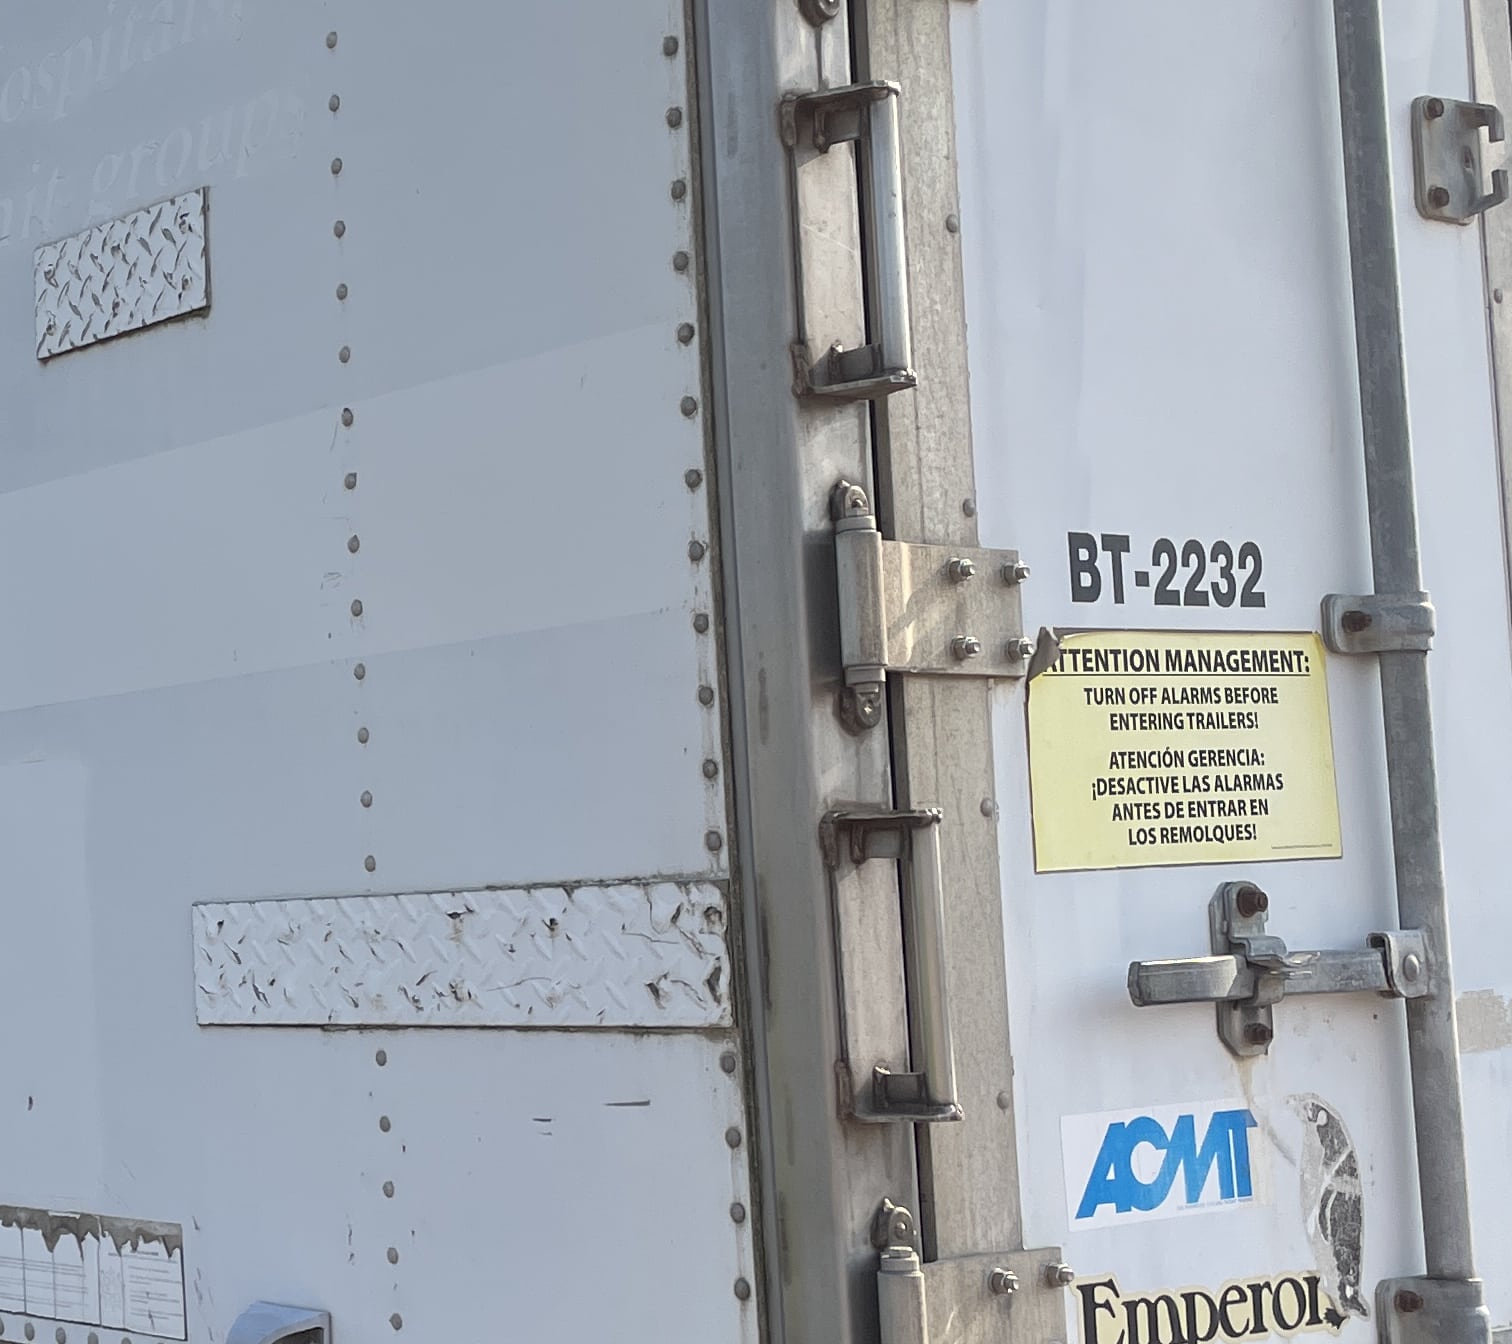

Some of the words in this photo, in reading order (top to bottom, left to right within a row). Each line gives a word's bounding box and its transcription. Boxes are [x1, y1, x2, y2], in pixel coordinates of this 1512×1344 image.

[1067, 532, 1266, 609] BT-2232
[1044, 649, 1160, 673] TTENTION
[1166, 649, 1310, 673] MANAGEMENT:
[1084, 688, 1126, 705] TURN
[1129, 688, 1157, 705] OFF
[1161, 687, 1222, 705] ALARMS
[1224, 687, 1279, 704] BEFORE
[1110, 713, 1184, 731] ENTERING
[1187, 712, 1259, 730] TRAILERS!
[1109, 746, 1185, 769] ATENCIÓN
[1188, 749, 1266, 767] GERENCIA:
[1092, 776, 1180, 801] ¡DESACTIVE
[1182, 775, 1211, 793] LAS
[1214, 773, 1284, 792] ALARMAS
[1112, 802, 1161, 821] ANTES
[1164, 801, 1185, 819] DE
[1188, 799, 1247, 818] ENTRAR
[1250, 799, 1269, 816] EN
[1128, 828, 1157, 846] LOS
[1160, 824, 1257, 844] REMOLQUES!
